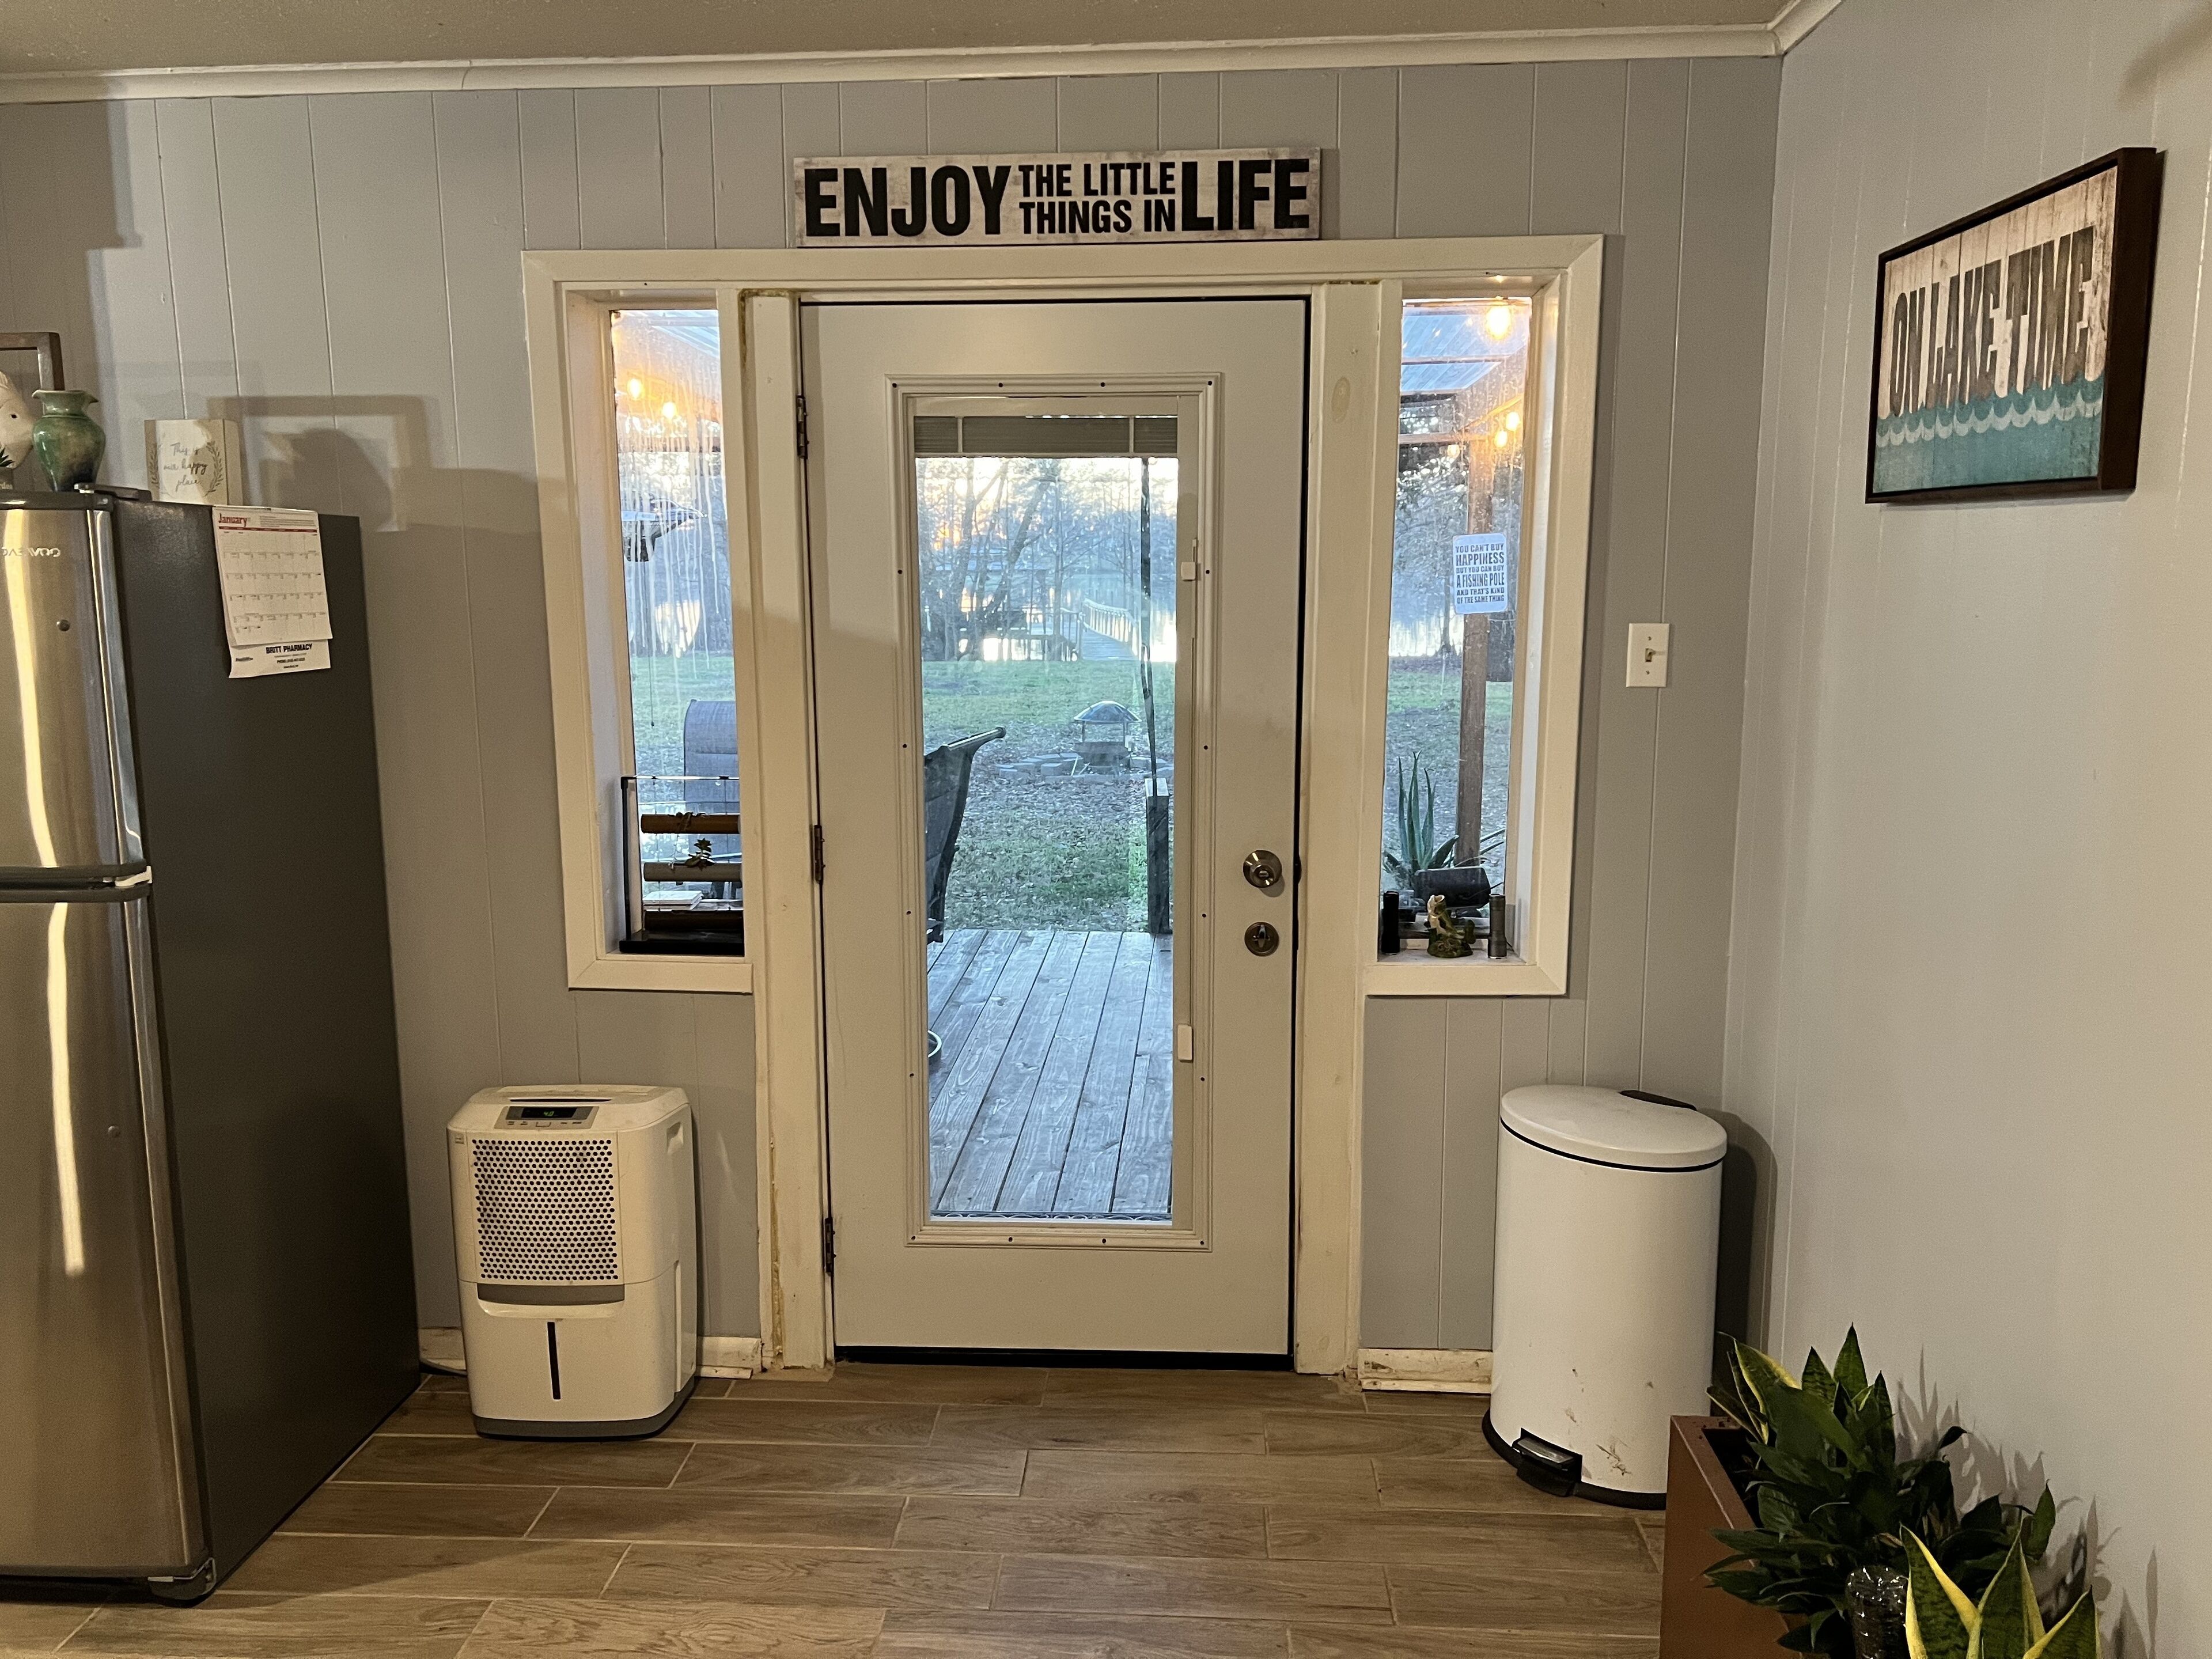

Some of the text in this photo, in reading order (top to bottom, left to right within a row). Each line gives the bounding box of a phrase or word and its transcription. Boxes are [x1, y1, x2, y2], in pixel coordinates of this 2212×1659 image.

[1018, 162, 1176, 198] THE LITTLE
[805, 165, 1012, 237] ENJOY
[1180, 158, 1310, 231] LIFE
[1019, 198, 1176, 235] THINGS IN
[1889, 225, 2094, 416] ON LAKE TIME
[181, 458, 208, 475] happy
[218, 513, 248, 527] January
[1471, 544, 1489, 552] CAN'T
[1456, 552, 1505, 566] HAPPINESS
[1456, 572, 1504, 588] A FISHING POLE
[266, 643, 313, 654] BRITT PHARMACY
